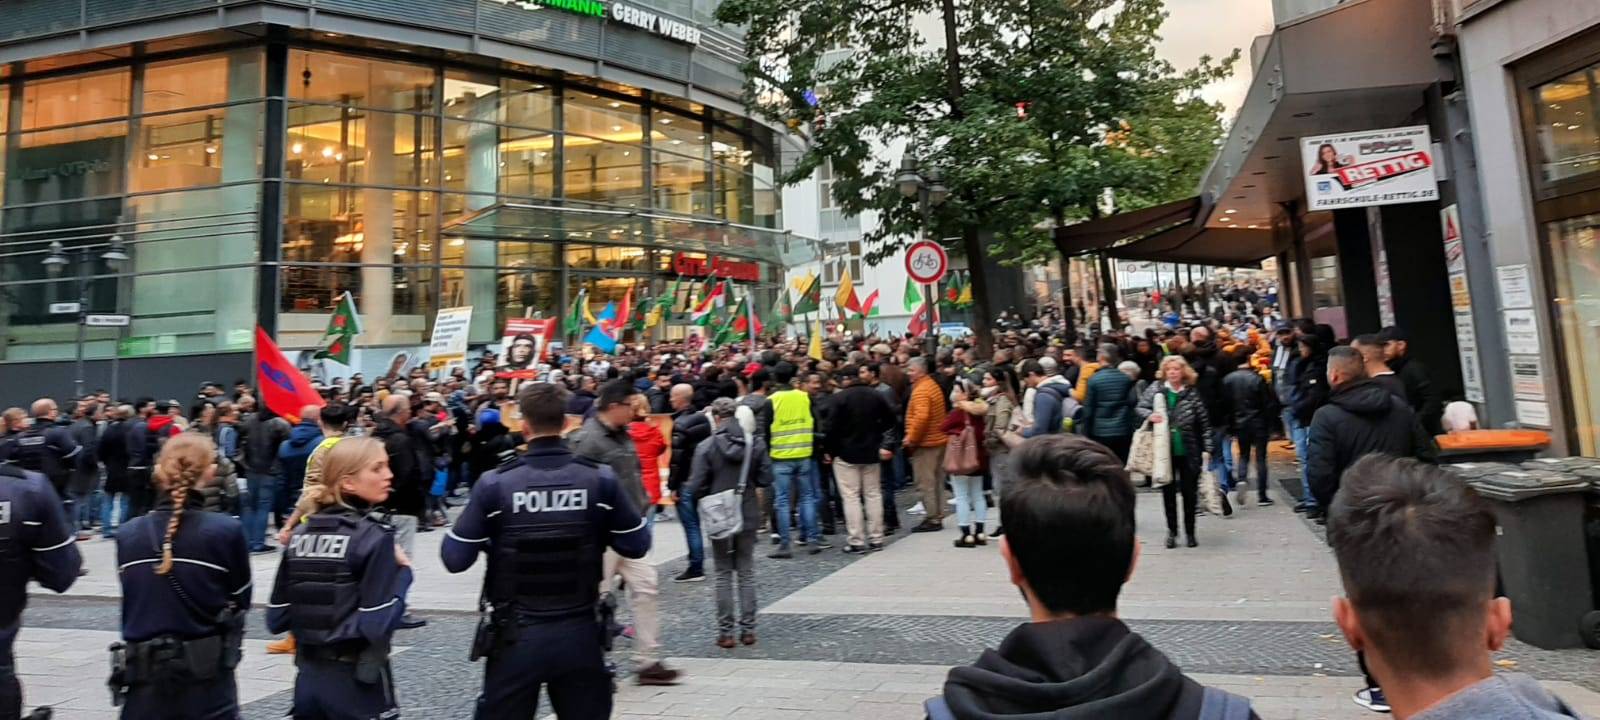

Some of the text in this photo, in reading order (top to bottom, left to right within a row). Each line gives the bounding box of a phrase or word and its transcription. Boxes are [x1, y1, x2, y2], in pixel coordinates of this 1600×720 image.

[545, 0, 602, 17] MANN
[612, 2, 701, 45] GERRY WEBER
[1346, 153, 1426, 181] RETTIG
[512, 488, 588, 514] POLIZEI
[289, 534, 351, 559] POLIZEI
